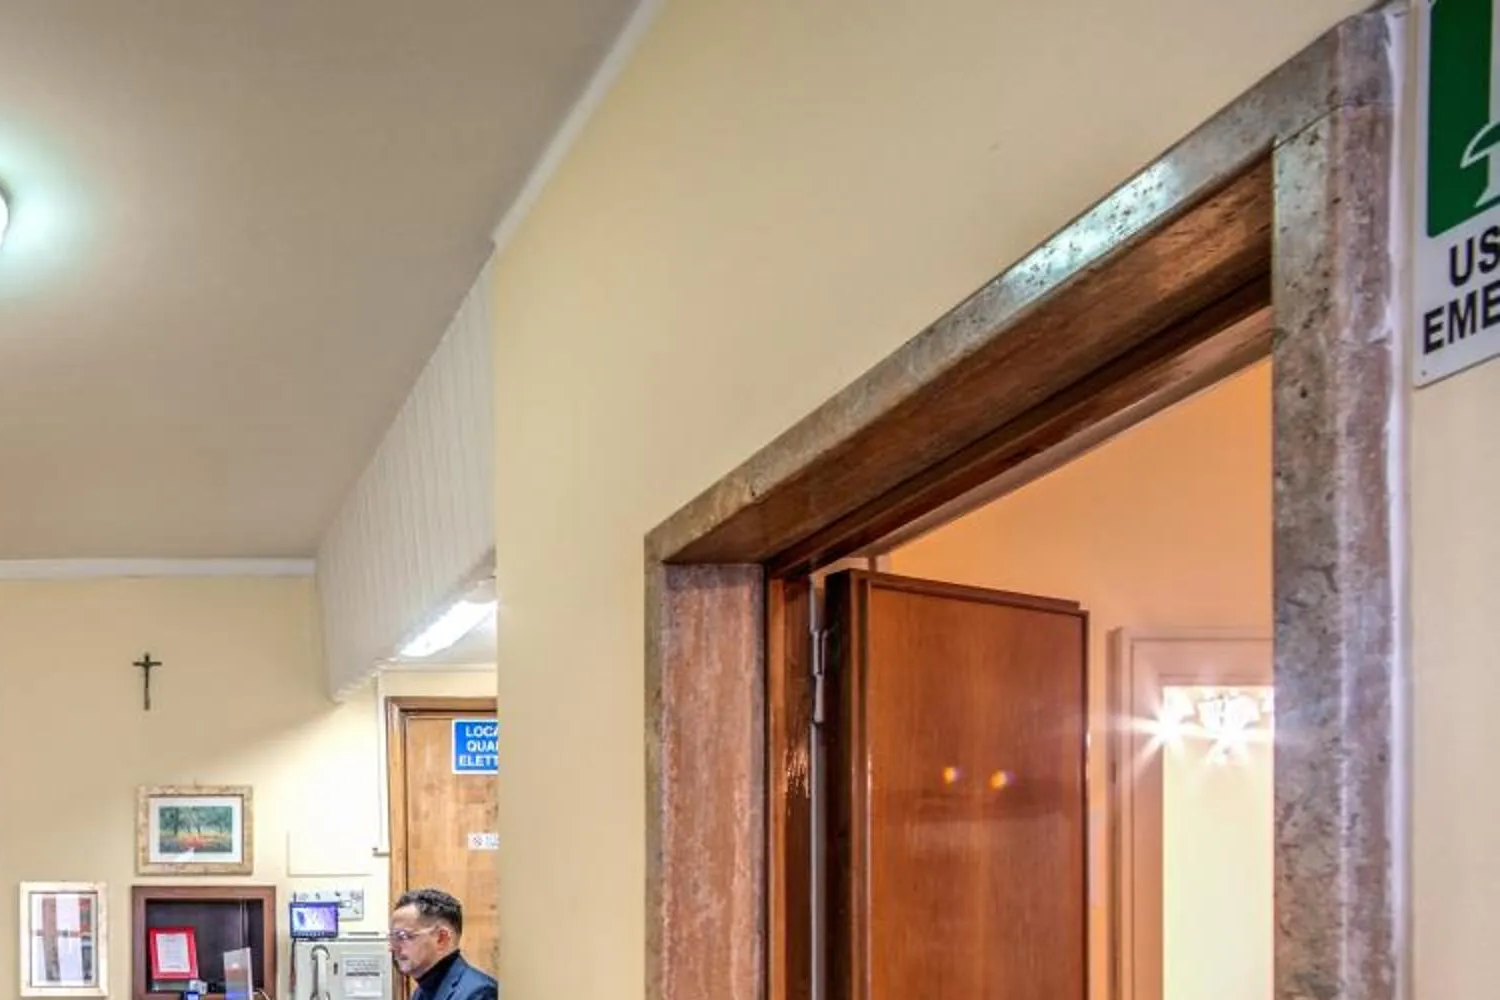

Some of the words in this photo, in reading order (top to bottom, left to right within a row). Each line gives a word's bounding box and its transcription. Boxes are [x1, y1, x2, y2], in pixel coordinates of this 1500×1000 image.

[1449, 225, 1500, 287] US
[1423, 280, 1500, 355] EME
[467, 741, 499, 752] QUA
